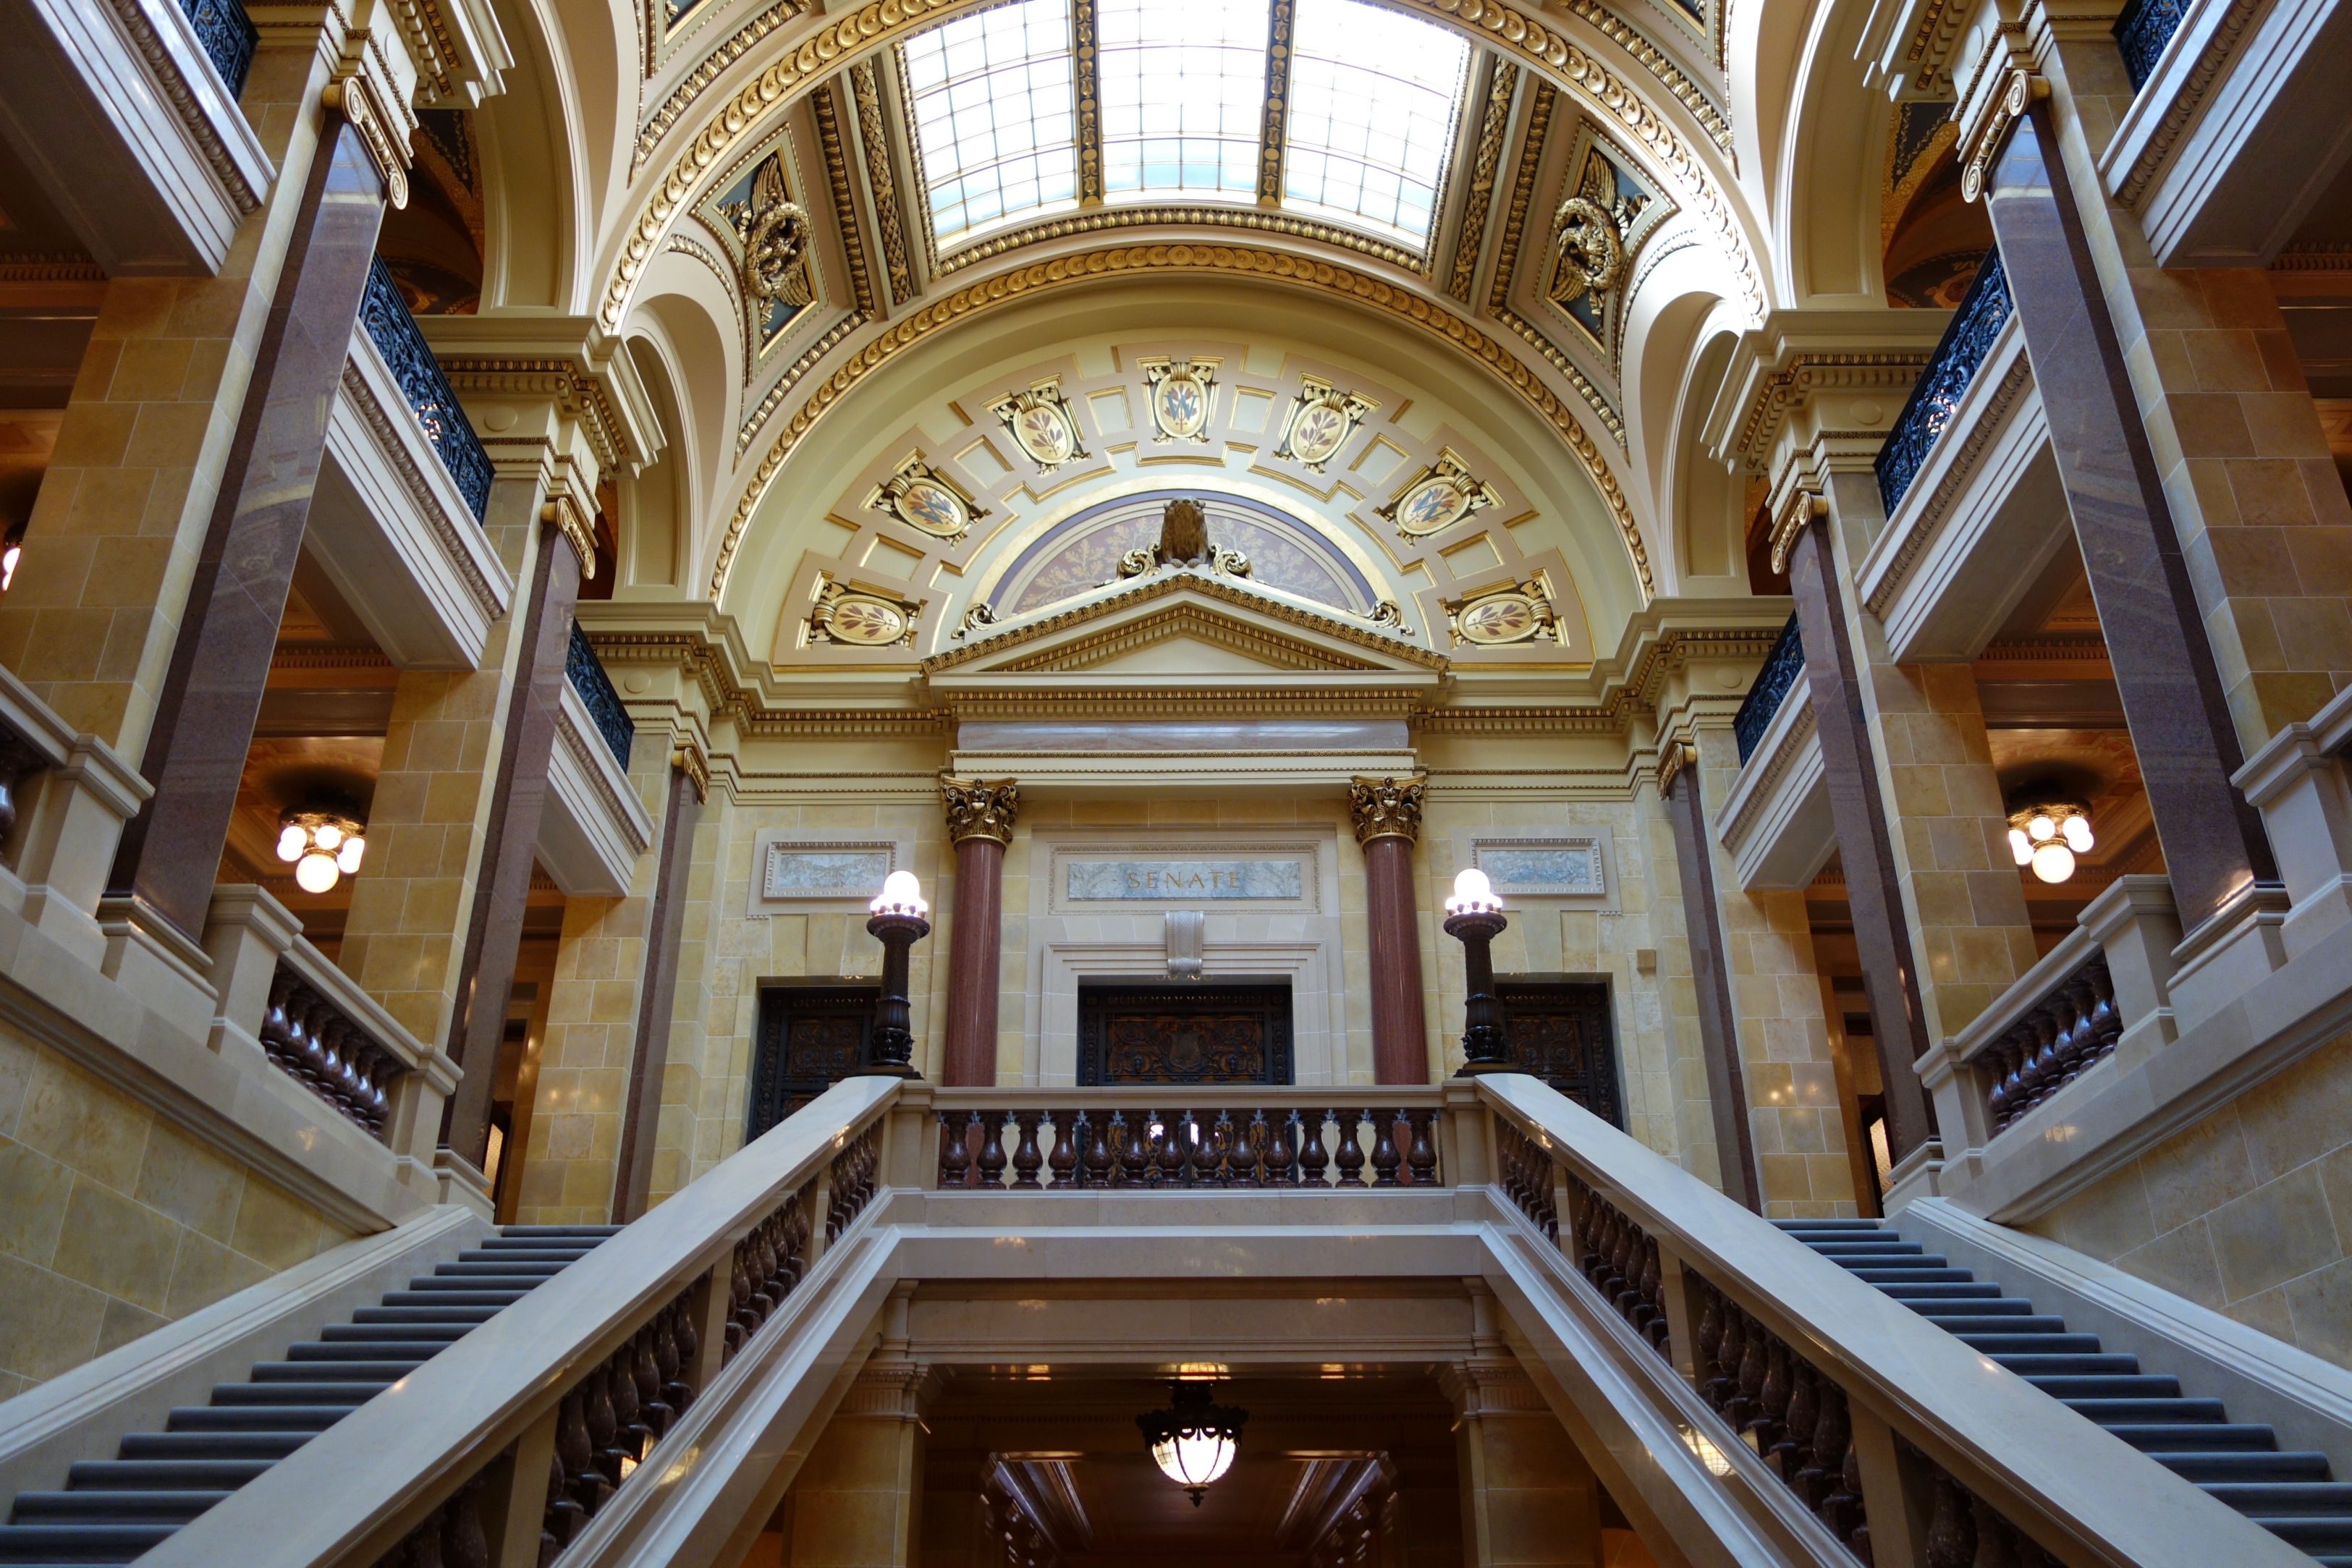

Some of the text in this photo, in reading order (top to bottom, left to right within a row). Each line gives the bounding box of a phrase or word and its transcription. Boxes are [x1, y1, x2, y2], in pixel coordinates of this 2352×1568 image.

[1163, 394, 1199, 421] W
[912, 490, 953, 525] W
[1411, 488, 1453, 522] W
[1127, 871, 1242, 889] SENATE
